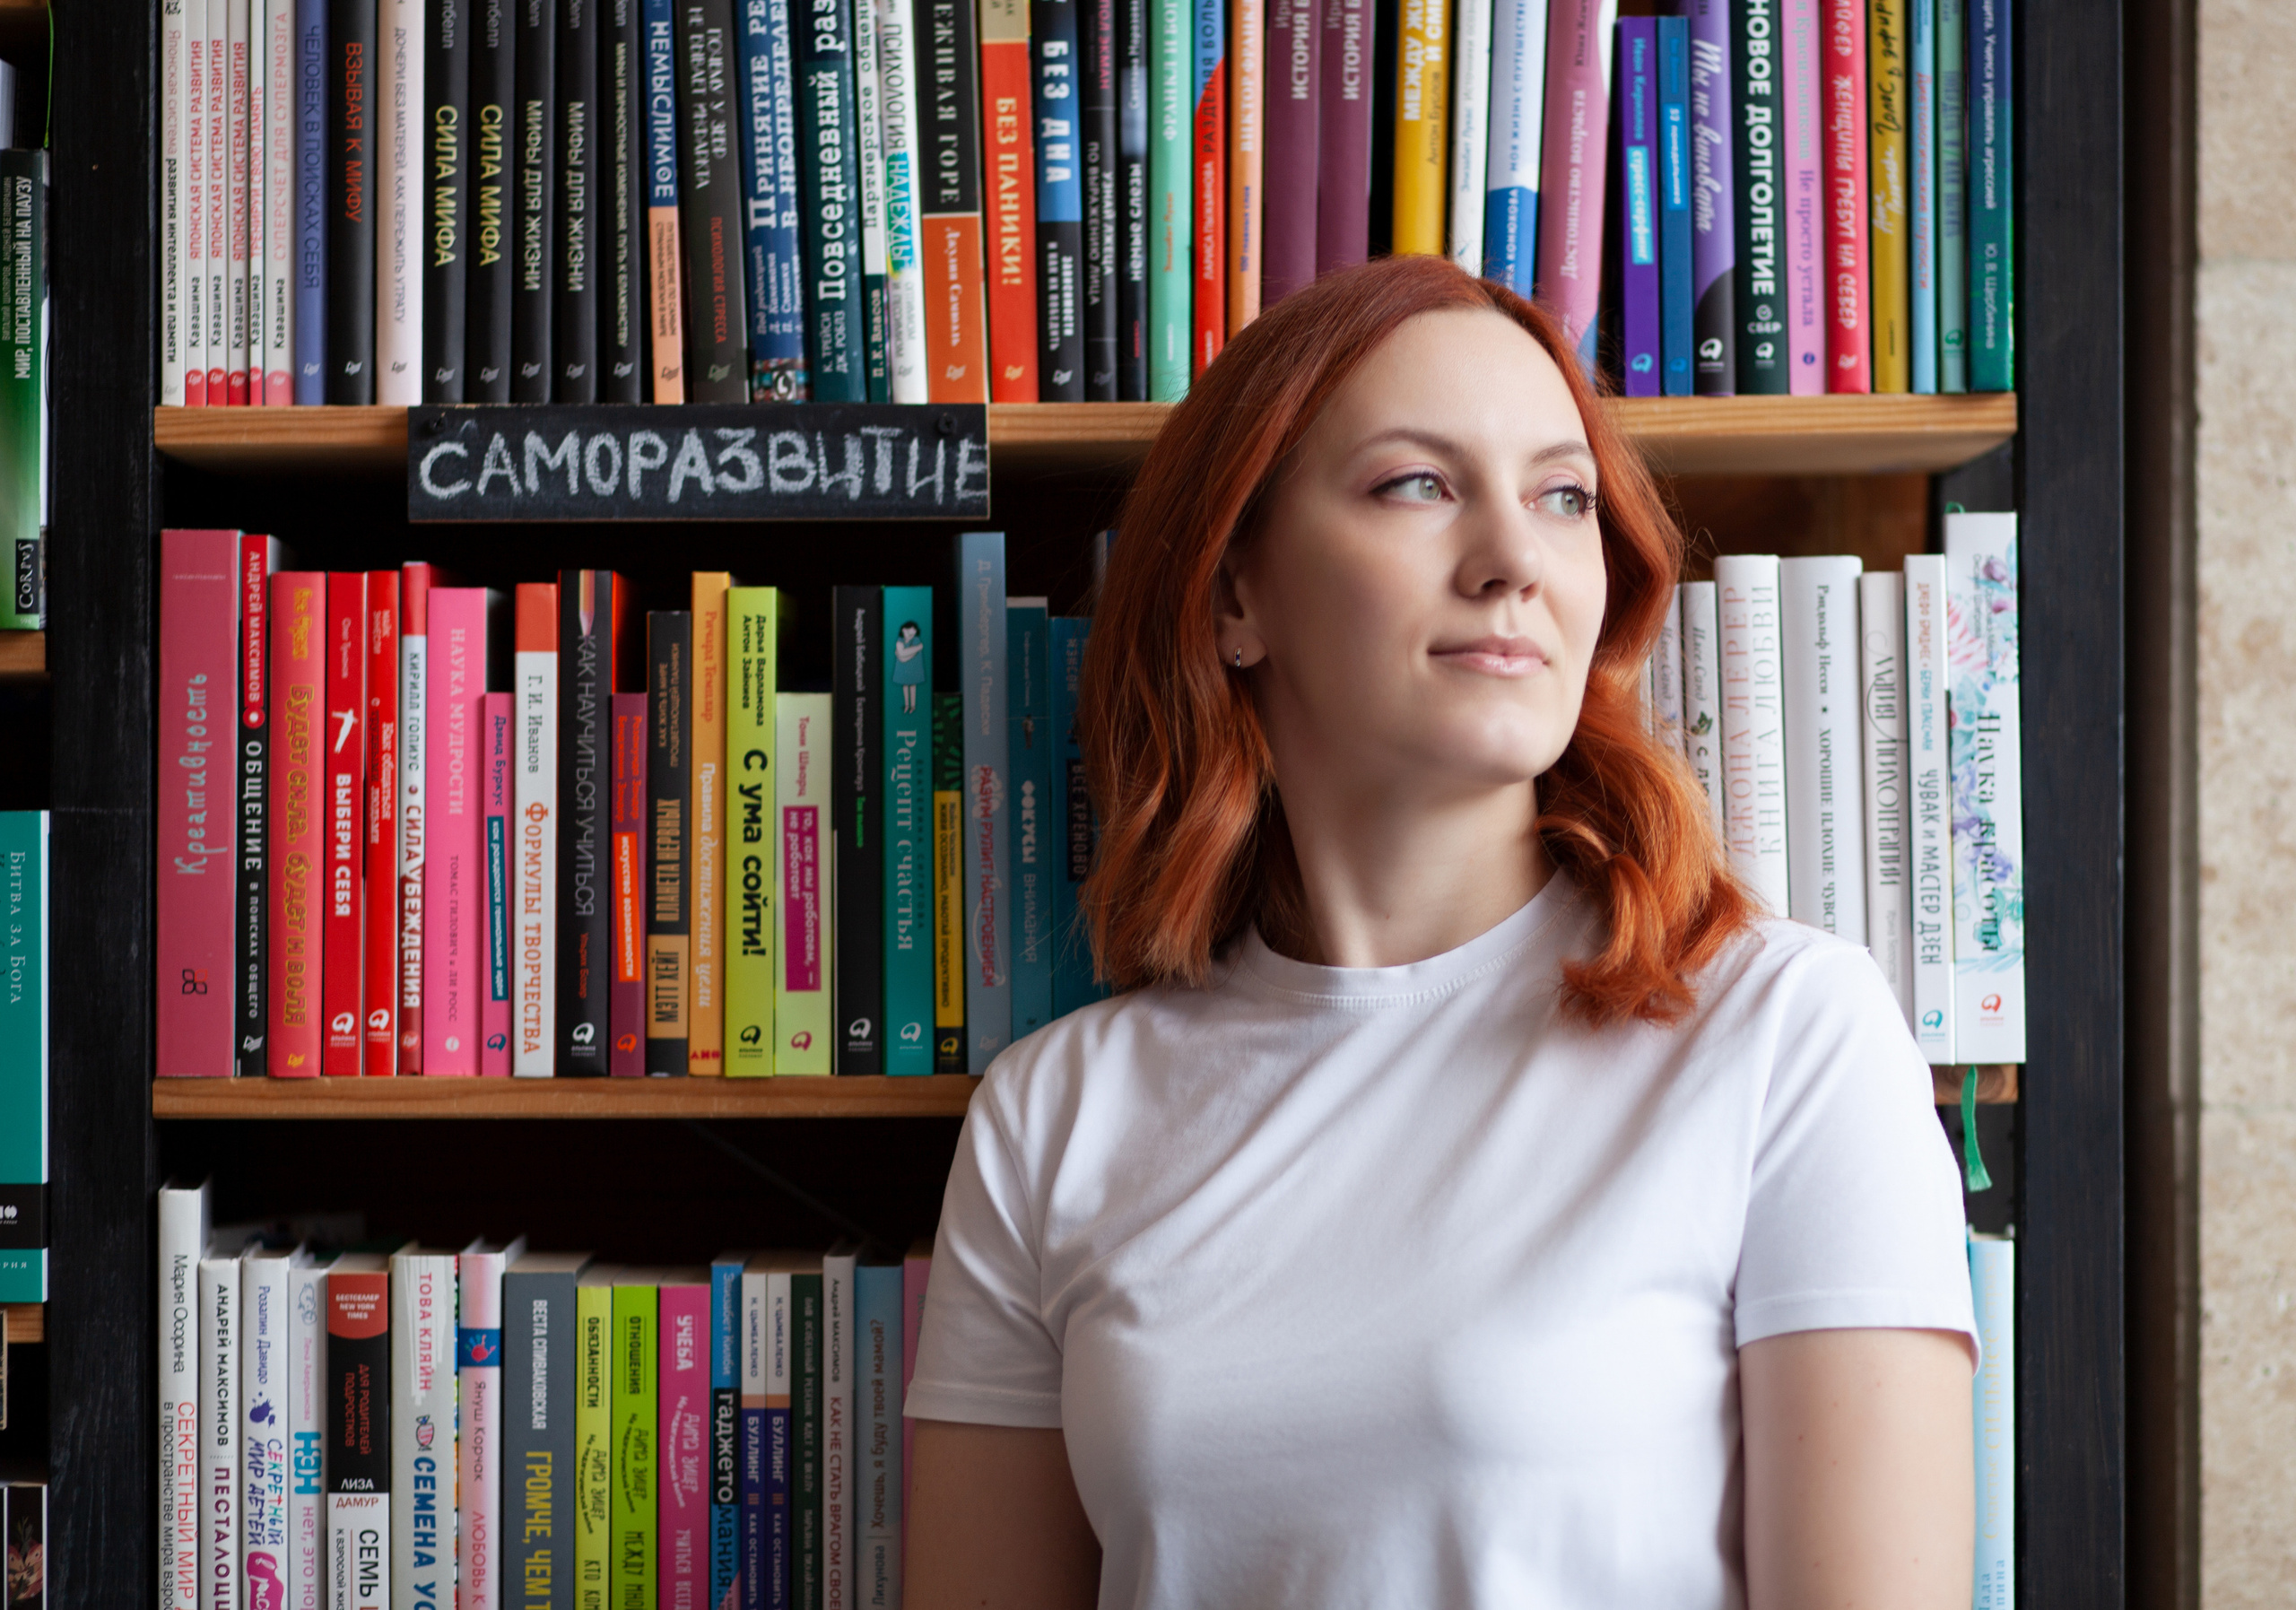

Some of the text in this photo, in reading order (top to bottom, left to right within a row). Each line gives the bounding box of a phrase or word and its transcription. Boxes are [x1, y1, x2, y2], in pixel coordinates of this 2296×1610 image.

[649, 22, 674, 198] НЕМЫСЛИМОЕ
[1041, 41, 1071, 183] БЕЗ ДНА
[1292, 13, 1309, 99] ИСТОРИЯ
[1344, 13, 1361, 100] ИСТОРИЯ
[1405, 37, 1422, 120] МЕЖДУ
[189, 40, 203, 347] Кавашима ЯПОНСКАЯ СИСТЕМА РАЗВИТИЯ
[210, 39, 223, 345] Кавашима ЯПОНСКАЯ СИСТЕМА РАЗВИТИЯ
[274, 13, 289, 348] Кавашима СУПЕРСЧЕТ ДЛЯ СУПЕРМОЗГА
[303, 25, 320, 288] ЧЕЛОВЕК В ПОИСКАХ СЕБЯ
[345, 42, 361, 222] ВЗЫВАЯ К МИФУ
[435, 105, 457, 266] СИЛА МИФА
[480, 105, 502, 265] СИЛА МИФА
[808, 71, 847, 300] Повседневный
[884, 24, 910, 265] ПСИХОЛОГИЯ НАДЕЖДЫ
[938, 135, 960, 204] ГОРЕ
[996, 98, 1022, 284] БЕЗ ПАНИКИ!
[1560, 91, 1586, 278] Достоинство возраста
[1916, 72, 1931, 290] Диетологические глупости
[232, 42, 246, 348] Кавашима ЯПОНСКАЯ СИСТЕМА РАЗВИТИЯ
[524, 100, 543, 290] МИФЫ ДЛЯ ЖИЗНИ
[565, 102, 584, 292] МИФЫ ДЛЯ ЖИЗНИ
[1087, 142, 1100, 305] ПО ВЫРАЖЕНИЮ ЛИЦА
[1101, 172, 1114, 274] УЗНАЙ ЛЖЕЦА
[1745, 104, 1774, 296] ДОЛГОЛЕТИЕ
[1797, 170, 1815, 326] Не просто устала
[1830, 74, 1858, 329] ЖЕНЩИНЫ ГРЕБУТ НА СЕВЕР
[13, 176, 33, 379] МИР, ПОСТАВЛЕННЫЙ НА ПАУЗУ
[420, 426, 987, 505] САМОРАЗВИТИЕ
[248, 552, 263, 702] АНДРЕЙ МАКСИМОВ
[659, 663, 667, 689] МИРЕ
[286, 685, 314, 766] Будет
[409, 653, 420, 771] КИРИЛЛ ГОПИУС
[448, 628, 465, 814] НАУКА МУДРОСТИ
[528, 674, 543, 773] Г. И. Иванов
[659, 699, 667, 724] ЖИТЬ
[659, 727, 667, 747] КАК
[670, 643, 680, 767] ПРОЦВЕТАЮЩЕЙ ПАНИКИ
[796, 717, 809, 796] Тони Шварц
[1752, 586, 1781, 855] КНИГА ЛЮБВИ
[174, 674, 228, 875] Креативность
[284, 770, 309, 843] сила,
[575, 635, 596, 916] КАК НАУЧИТЬСЯ УЧИТЬСЯ
[1918, 769, 1939, 824] ЧУВАК
[1971, 714, 2001, 952] Наука красоты
[284, 852, 311, 931] будет
[335, 773, 351, 917] ВЫБЕРИ СЕБЯ
[657, 799, 681, 921] ПЛАНЕТА НЕРВНЫХ
[738, 749, 768, 956] С ума сойти!
[890, 729, 917, 950] Рецепт счастья
[1919, 846, 1940, 914] МАСТЕР
[287, 936, 304, 953] и
[402, 805, 421, 1007] СИЛА УБЕЖДЕНИЯ
[1918, 921, 1942, 964] ДЗЕН
[285, 961, 305, 1025] воля
[652, 949, 678, 1022] МЭТТ ХЕЙГ
[170, 1255, 187, 1373] Мария Осорина
[419, 1273, 433, 1391] ТОВА КЛЯЙН
[630, 1317, 641, 1394] ОТНОШЕНИЯ
[676, 1315, 692, 1370] УЧЕБА
[723, 1273, 734, 1374] Элизабет Килби
[831, 1279, 839, 1318] Андрей
[217, 1284, 230, 1447] АНДРЕЙ МАКСИМОВ
[587, 1317, 599, 1407] ОБЯЗАННОСТИ
[161, 1402, 173, 1565] в пространстве мира
[177, 1402, 197, 1599] СЕКРЕТНЫЙ МИР
[248, 1437, 265, 1545] МИР ДЕТЕЙ
[268, 1440, 283, 1545] СЕКРЕТНЫЙ
[336, 1497, 378, 1509] ДАМУР
[341, 1478, 374, 1491] ЛИЗА
[773, 1416, 783, 1483] БУЛЛИНГ
[830, 1397, 841, 1564] КАК НЕ СТАТЬ ВРАГОМ
[360, 1529, 378, 1597] СЕМЬ
[413, 1458, 436, 1568] СЕМЕНА
[472, 1511, 485, 1604] ЛЮБОВЬ К
[522, 1451, 552, 1596] ГРОМЧЕ, ЧЕМ
[773, 1538, 781, 1604] ОСТАНОВИТЬ
